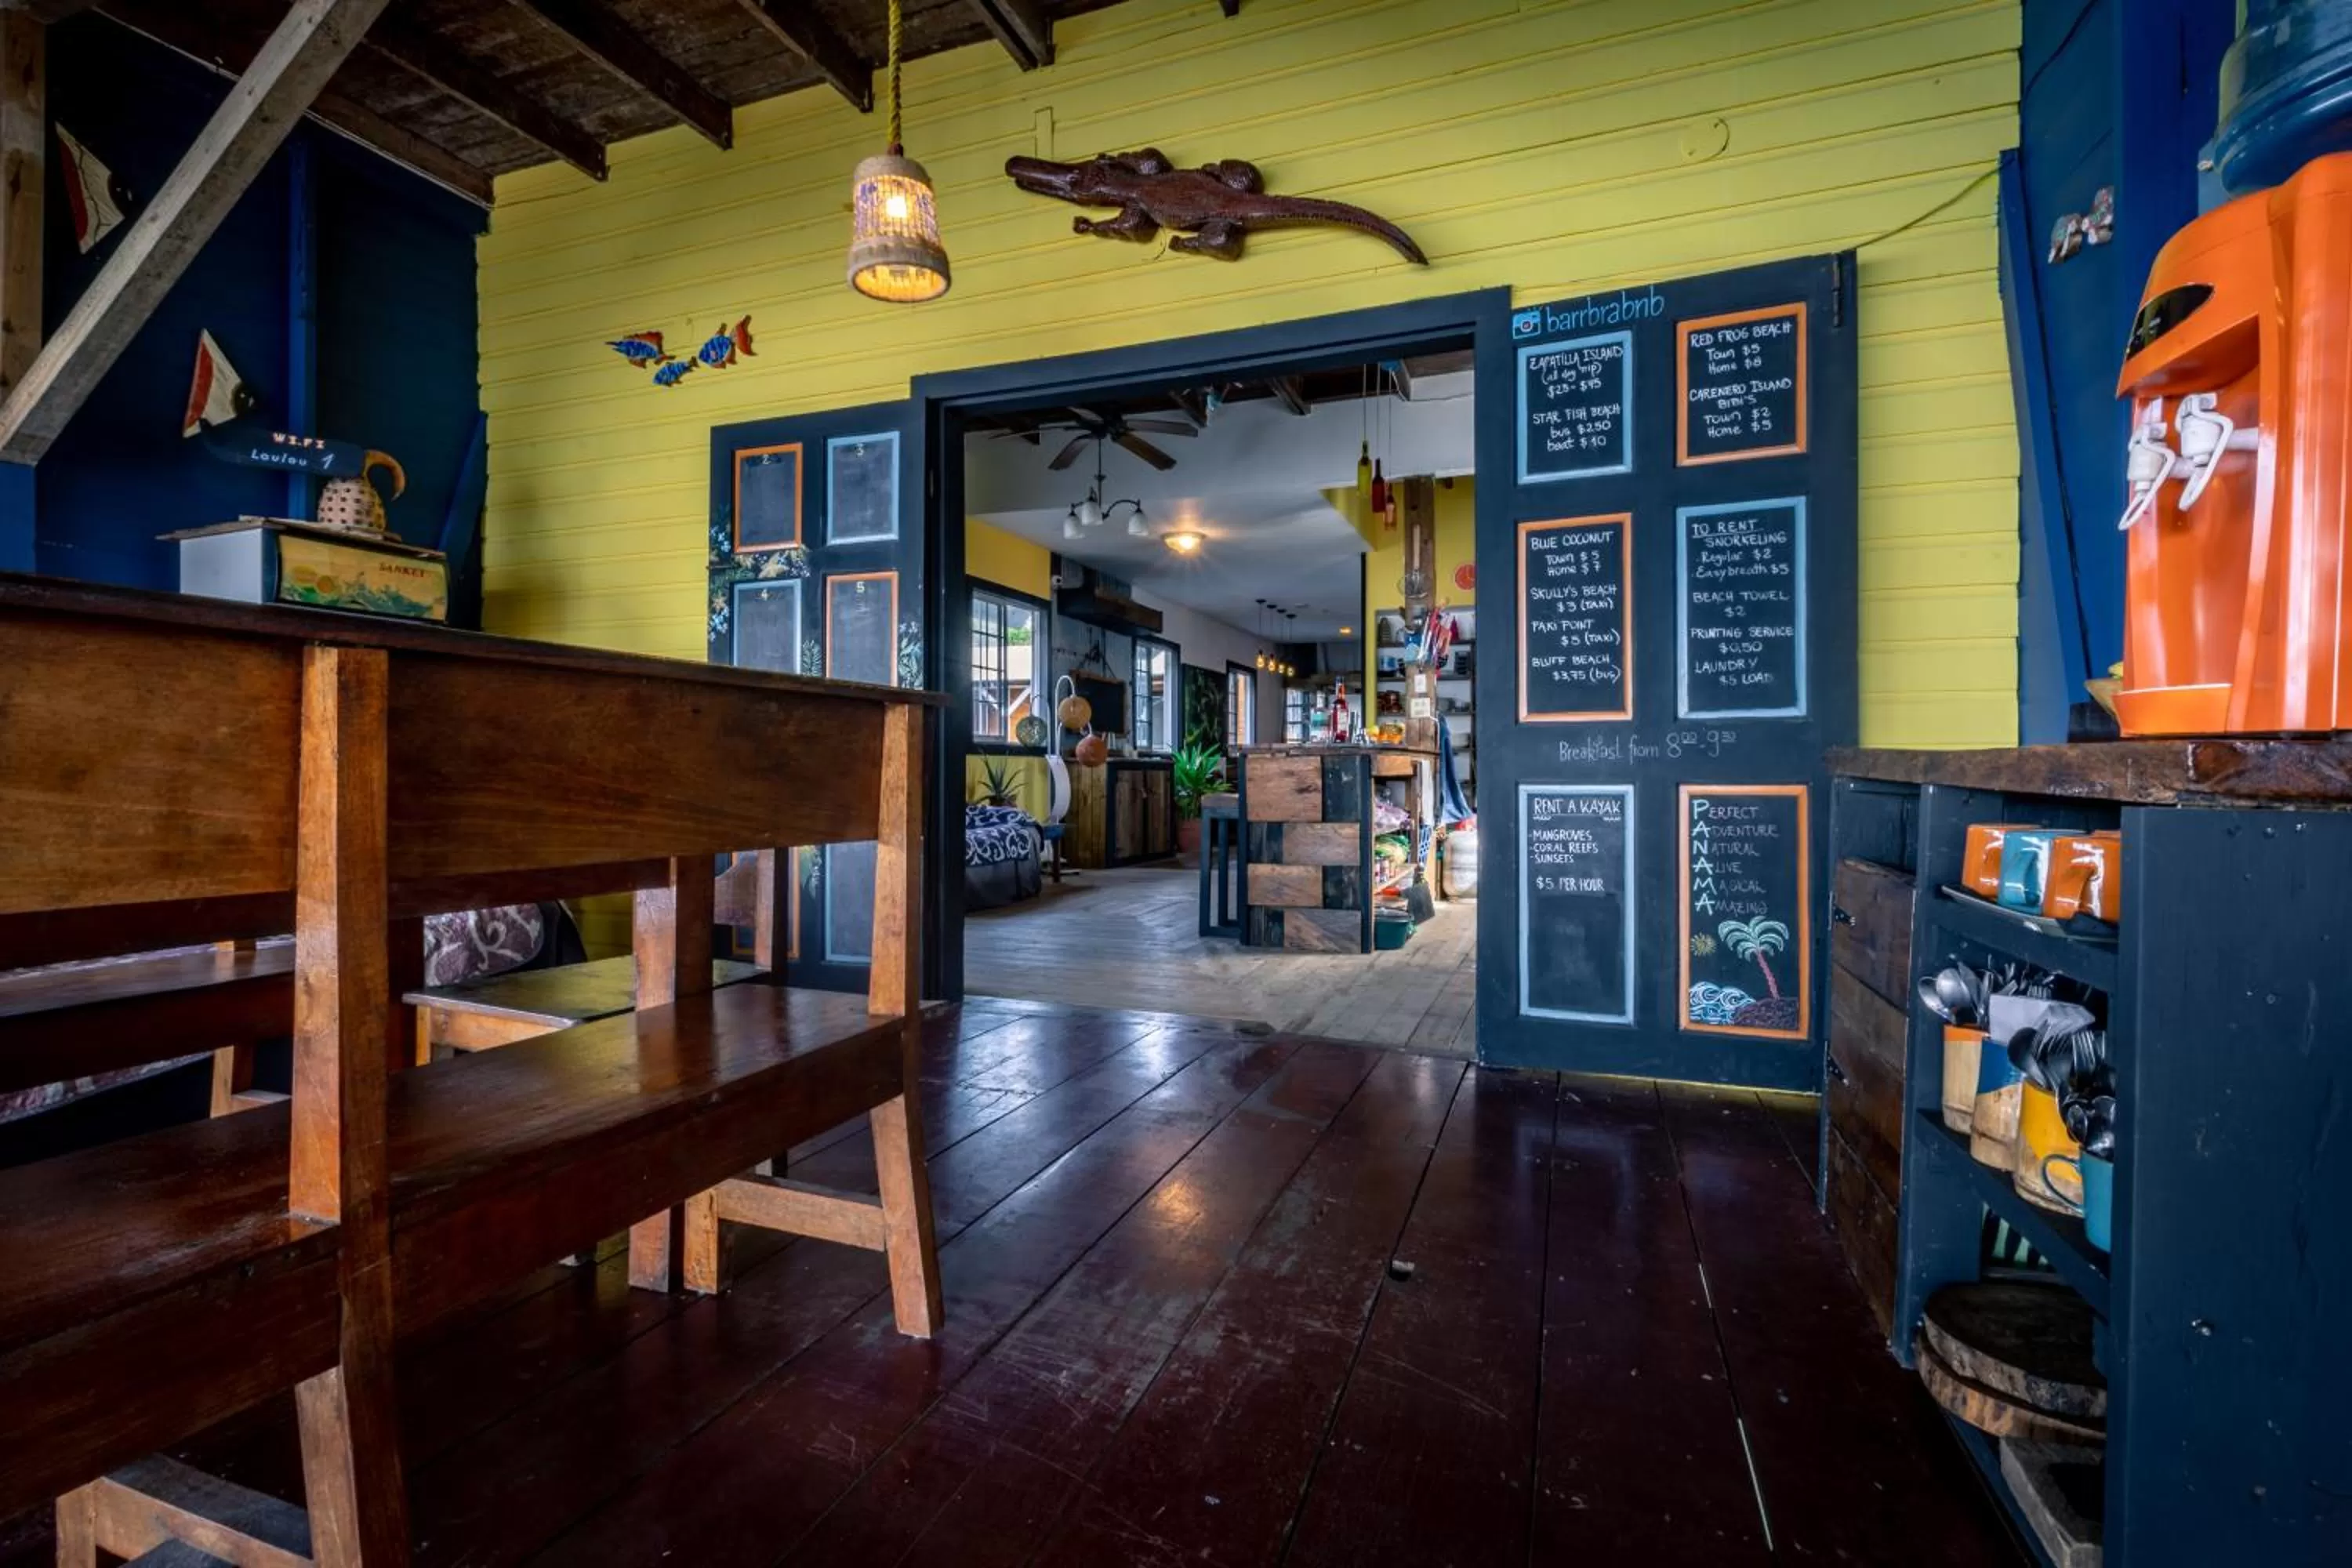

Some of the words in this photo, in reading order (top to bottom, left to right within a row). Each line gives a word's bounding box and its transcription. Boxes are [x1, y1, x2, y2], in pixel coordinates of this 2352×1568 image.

[1547, 285, 1664, 332] barrbrabnb
[1690, 333, 1714, 347] RED
[1717, 327, 1749, 343] FROG
[1752, 321, 1792, 338] BEACH
[1530, 352, 1579, 370] ZAPATILLA
[1583, 346, 1624, 361] ISLAND
[1706, 347, 1735, 361] Town
[1741, 343, 1761, 356] $5
[1708, 361, 1737, 375] Home
[1744, 357, 1762, 370] $8
[1689, 383, 1747, 401] CARENERO
[1749, 377, 1792, 393] ISLAND
[1532, 411, 1562, 425] STAR
[1564, 407, 1587, 421] FISH
[1590, 403, 1621, 419] BEACH
[1751, 405, 1772, 420] $2
[1706, 426, 1743, 438] Home
[1751, 419, 1773, 433] $5
[251, 448, 307, 466] Loulou
[1691, 523, 1709, 535] TO
[1717, 518, 1759, 533] RENT
[1530, 536, 1558, 550] BLUE
[1562, 531, 1614, 546] COCONUT
[1704, 531, 1788, 548] SNORKELING
[1752, 548, 1772, 561] $2
[1769, 563, 1790, 575] $5
[1581, 584, 1617, 598] BEACH
[1693, 590, 1733, 604] BEACH
[1739, 590, 1791, 603] TOWEL
[1724, 604, 1747, 619] $2
[1559, 619, 1596, 632] POINT
[1690, 627, 1742, 639] PRINTING
[1748, 626, 1794, 638] SERVICE
[1531, 656, 1566, 668] BLUFF
[1572, 654, 1610, 666] BEACH
[1693, 656, 1759, 675] LAUNDRY
[1741, 672, 1775, 684] LOAD
[1559, 734, 1624, 763] Breakfast
[1628, 734, 1660, 765] from
[1534, 797, 1564, 815] RENT
[1567, 800, 1576, 813] A
[1580, 799, 1621, 815] KAYAK
[1692, 799, 1759, 820] PERFECT
[1692, 821, 1779, 838] ADVENTURE
[1568, 842, 1599, 854] REEFS
[1693, 840, 1761, 857] NATURAL
[1692, 856, 1743, 875] ALIVE
[1536, 876, 1554, 890] $5
[1559, 877, 1577, 891] PER
[1580, 877, 1605, 891] HOUR
[1694, 892, 1769, 916] AMAZING
